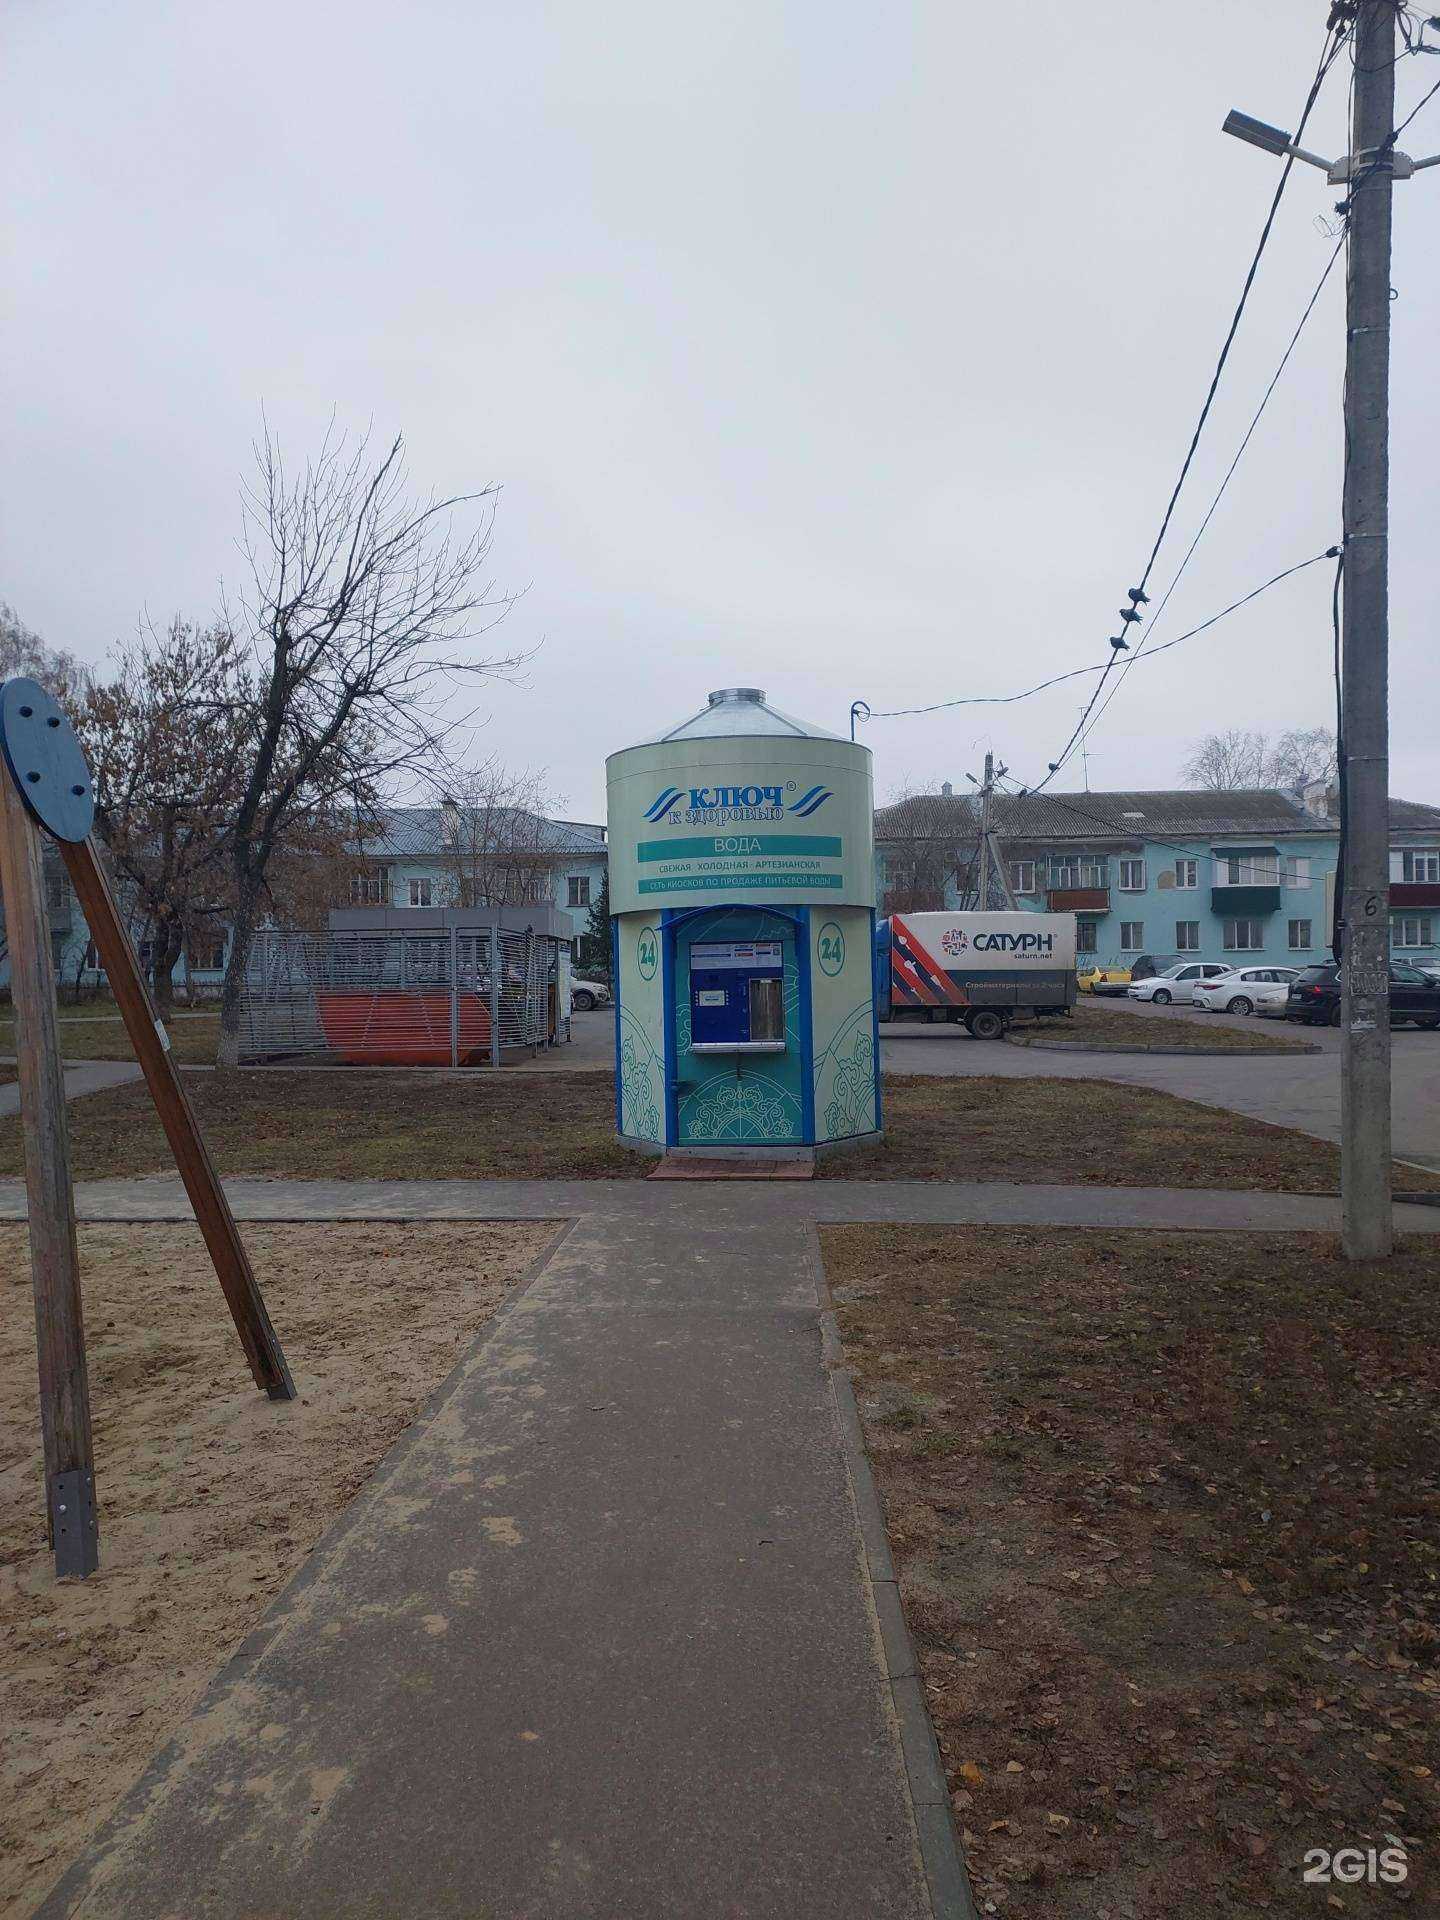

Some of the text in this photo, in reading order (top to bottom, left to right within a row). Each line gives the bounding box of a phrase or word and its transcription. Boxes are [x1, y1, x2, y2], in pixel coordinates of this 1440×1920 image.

[685, 806, 784, 826] здоровью
[714, 837, 762, 853] ВОДА
[659, 860, 821, 873] СВЕЖАЯ ХОЛОДНАЯ АРТЕЗИАНСКАЯ
[667, 879, 704, 889] КИОСКОВ
[706, 878, 719, 887] ПО
[720, 877, 764, 887] ПРОДАЖЕ
[765, 875, 808, 886] ПИТЬЕВОЙ
[1364, 896, 1378, 917] 6
[821, 936, 842, 963] 24
[973, 933, 1052, 951] САТУРН
[640, 941, 655, 967] 24
[1014, 952, 1053, 960] saturn.net
